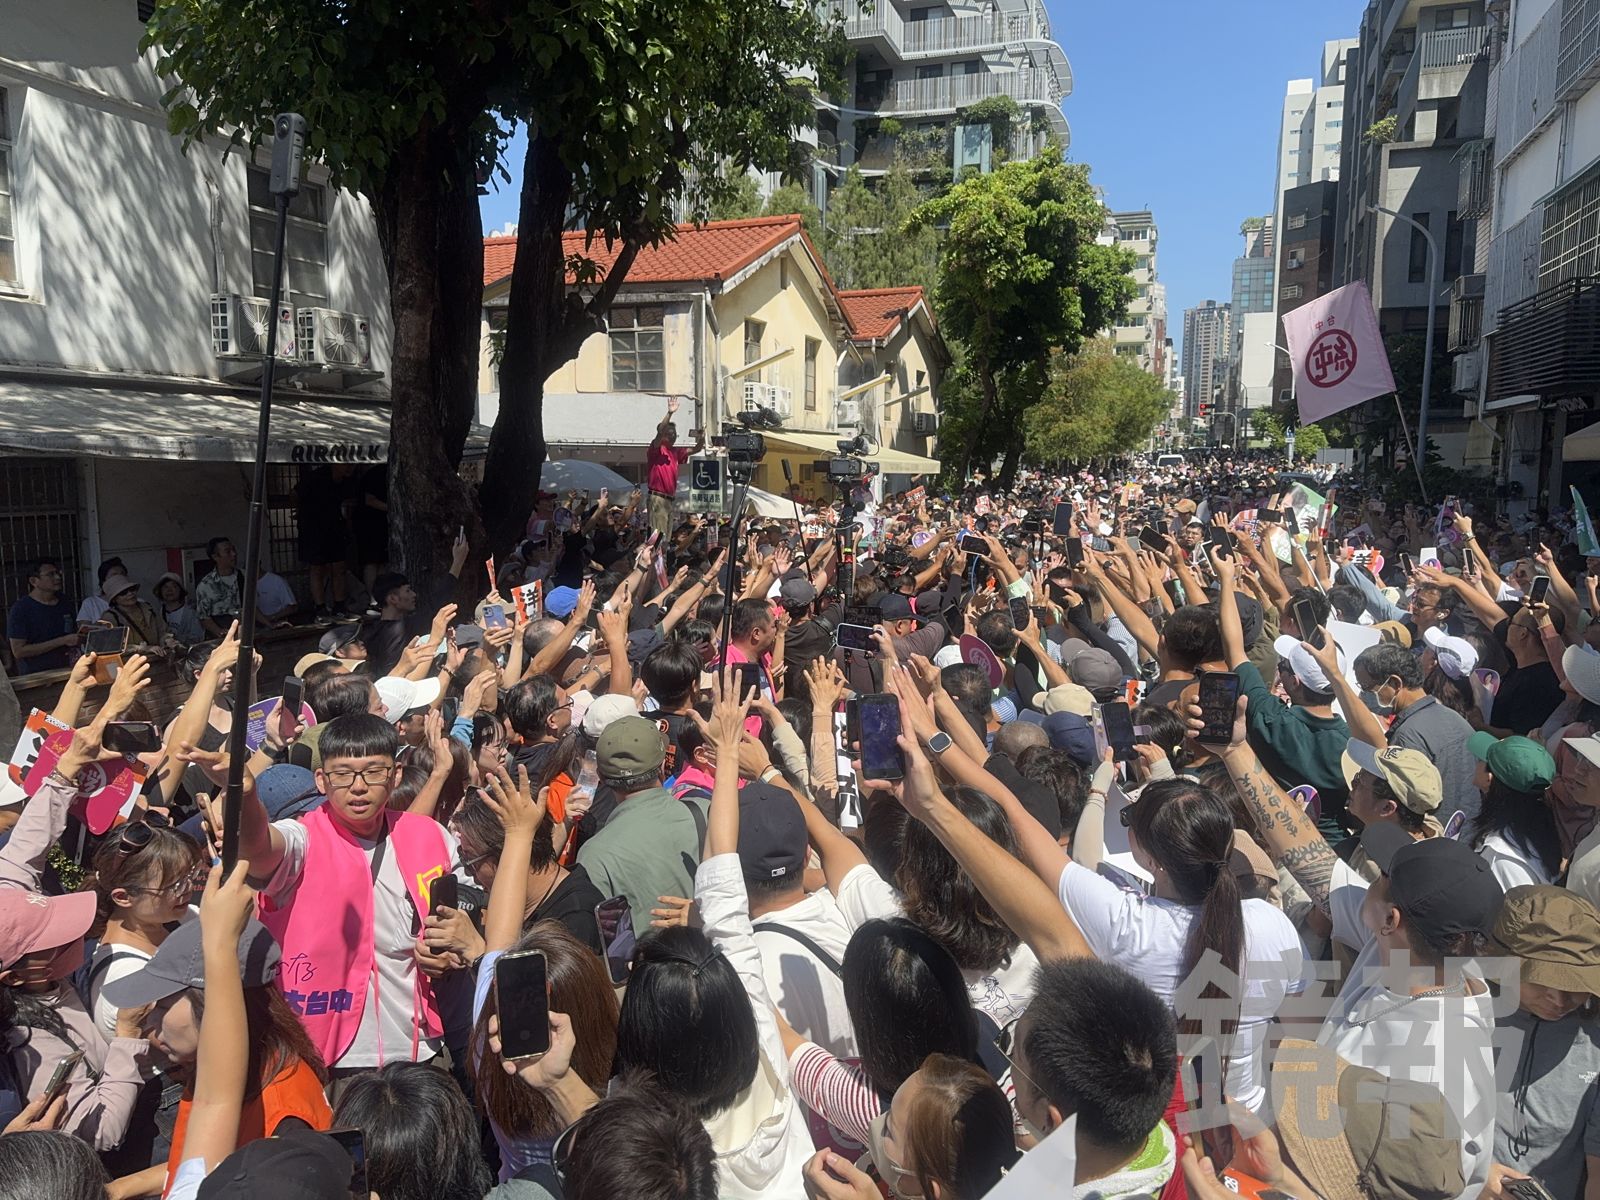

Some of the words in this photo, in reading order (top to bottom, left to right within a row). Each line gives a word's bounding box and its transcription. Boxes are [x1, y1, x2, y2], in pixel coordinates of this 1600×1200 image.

[291, 444, 381, 461] AIRMILK
[284, 988, 353, 1015] 大台中
